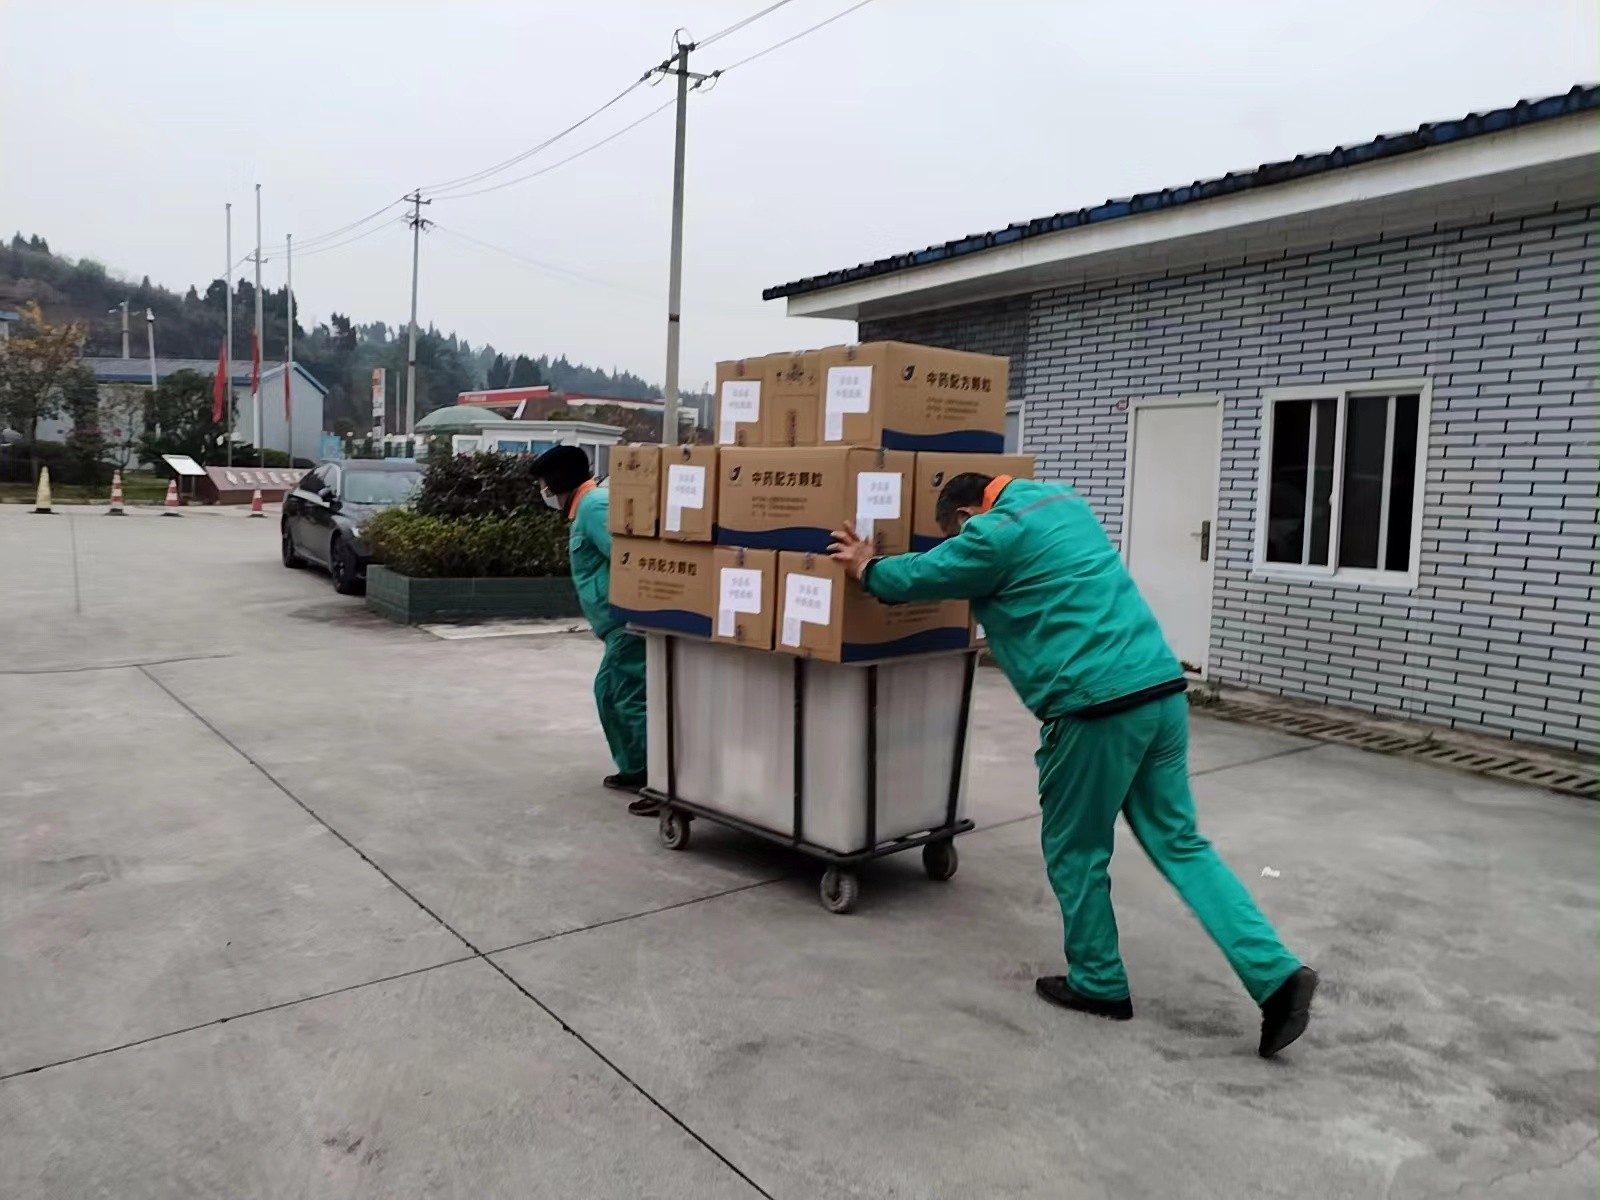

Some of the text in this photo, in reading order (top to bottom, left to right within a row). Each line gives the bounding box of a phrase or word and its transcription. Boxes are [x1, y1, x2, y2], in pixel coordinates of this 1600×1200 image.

[926, 370, 991, 393] 中药配方颗粒
[751, 470, 823, 487] 中药配方颗粒
[638, 557, 697, 576] 中药配方颗粒
